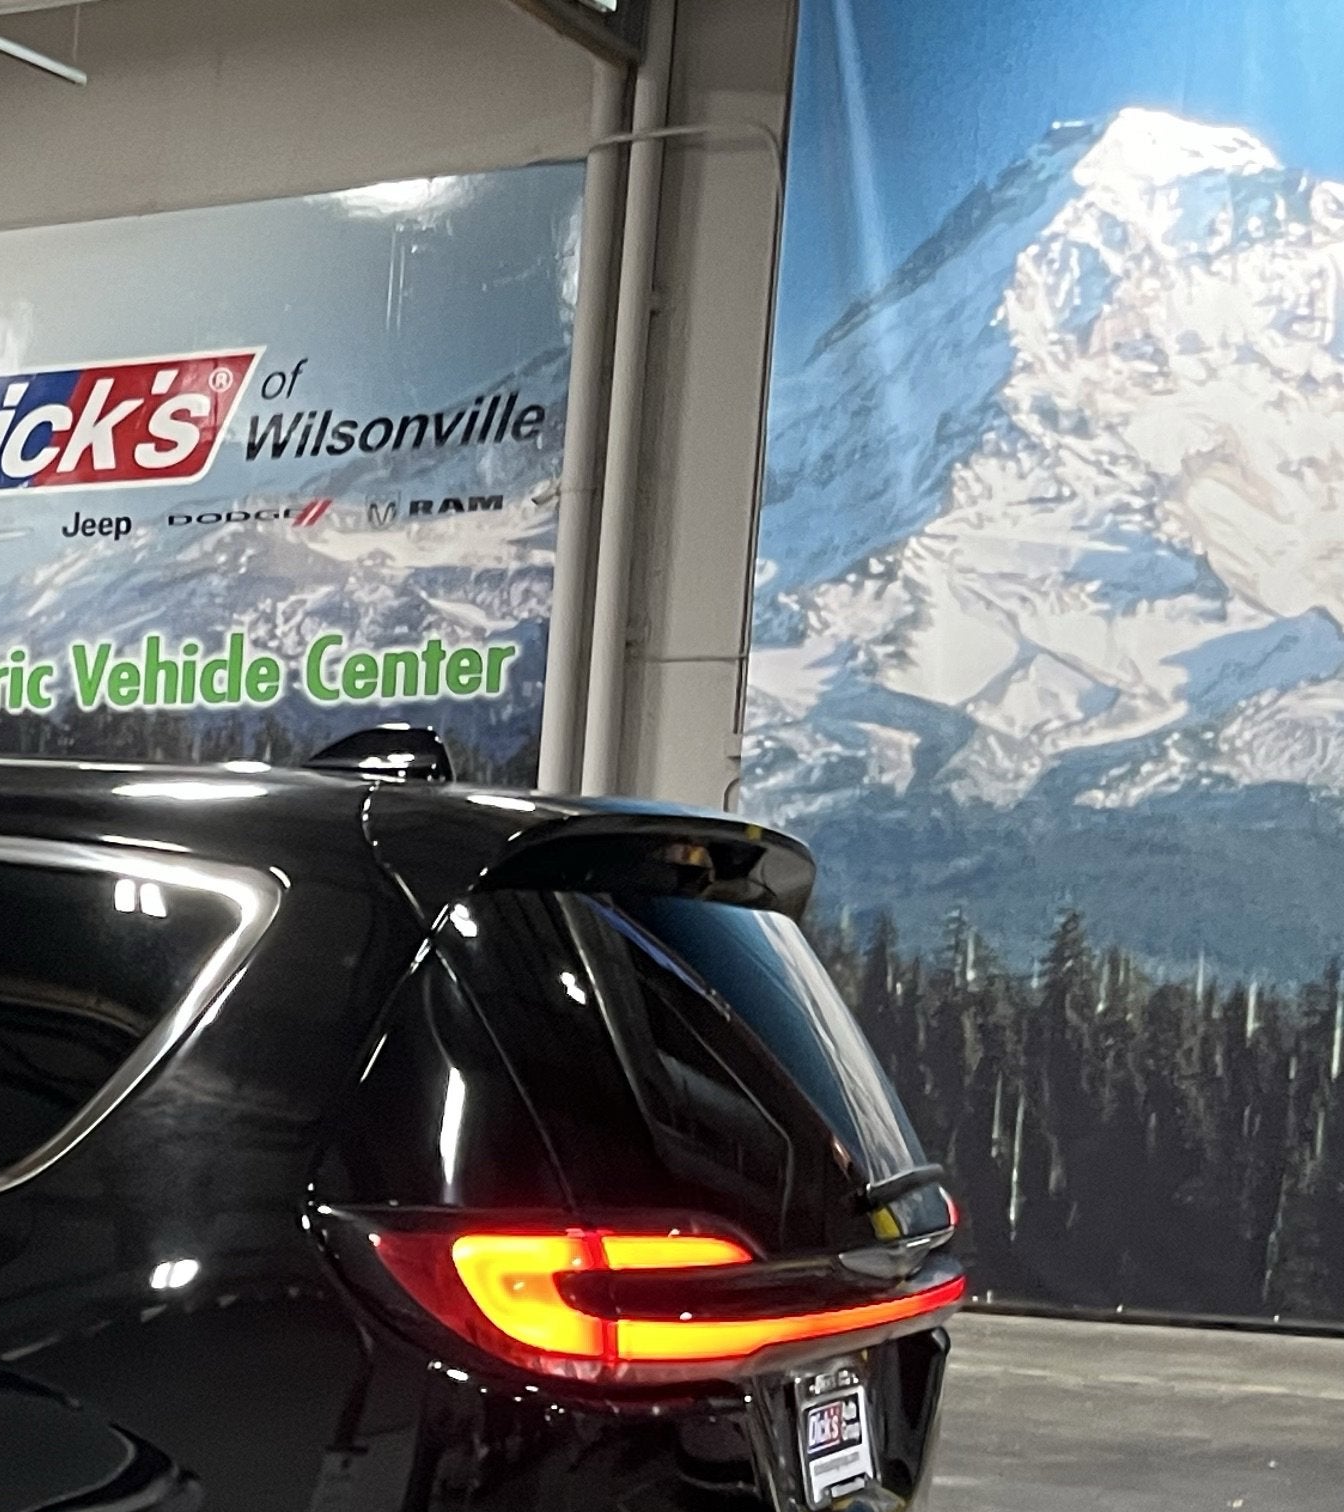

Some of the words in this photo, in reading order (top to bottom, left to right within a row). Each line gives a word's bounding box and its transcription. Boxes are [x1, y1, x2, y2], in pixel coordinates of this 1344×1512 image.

[261, 358, 308, 400] of
[245, 389, 546, 462] Wilsonville
[62, 511, 132, 541] Jeep
[409, 495, 504, 515] RAM
[71, 633, 281, 708] Vehicle
[305, 634, 516, 700] Center
